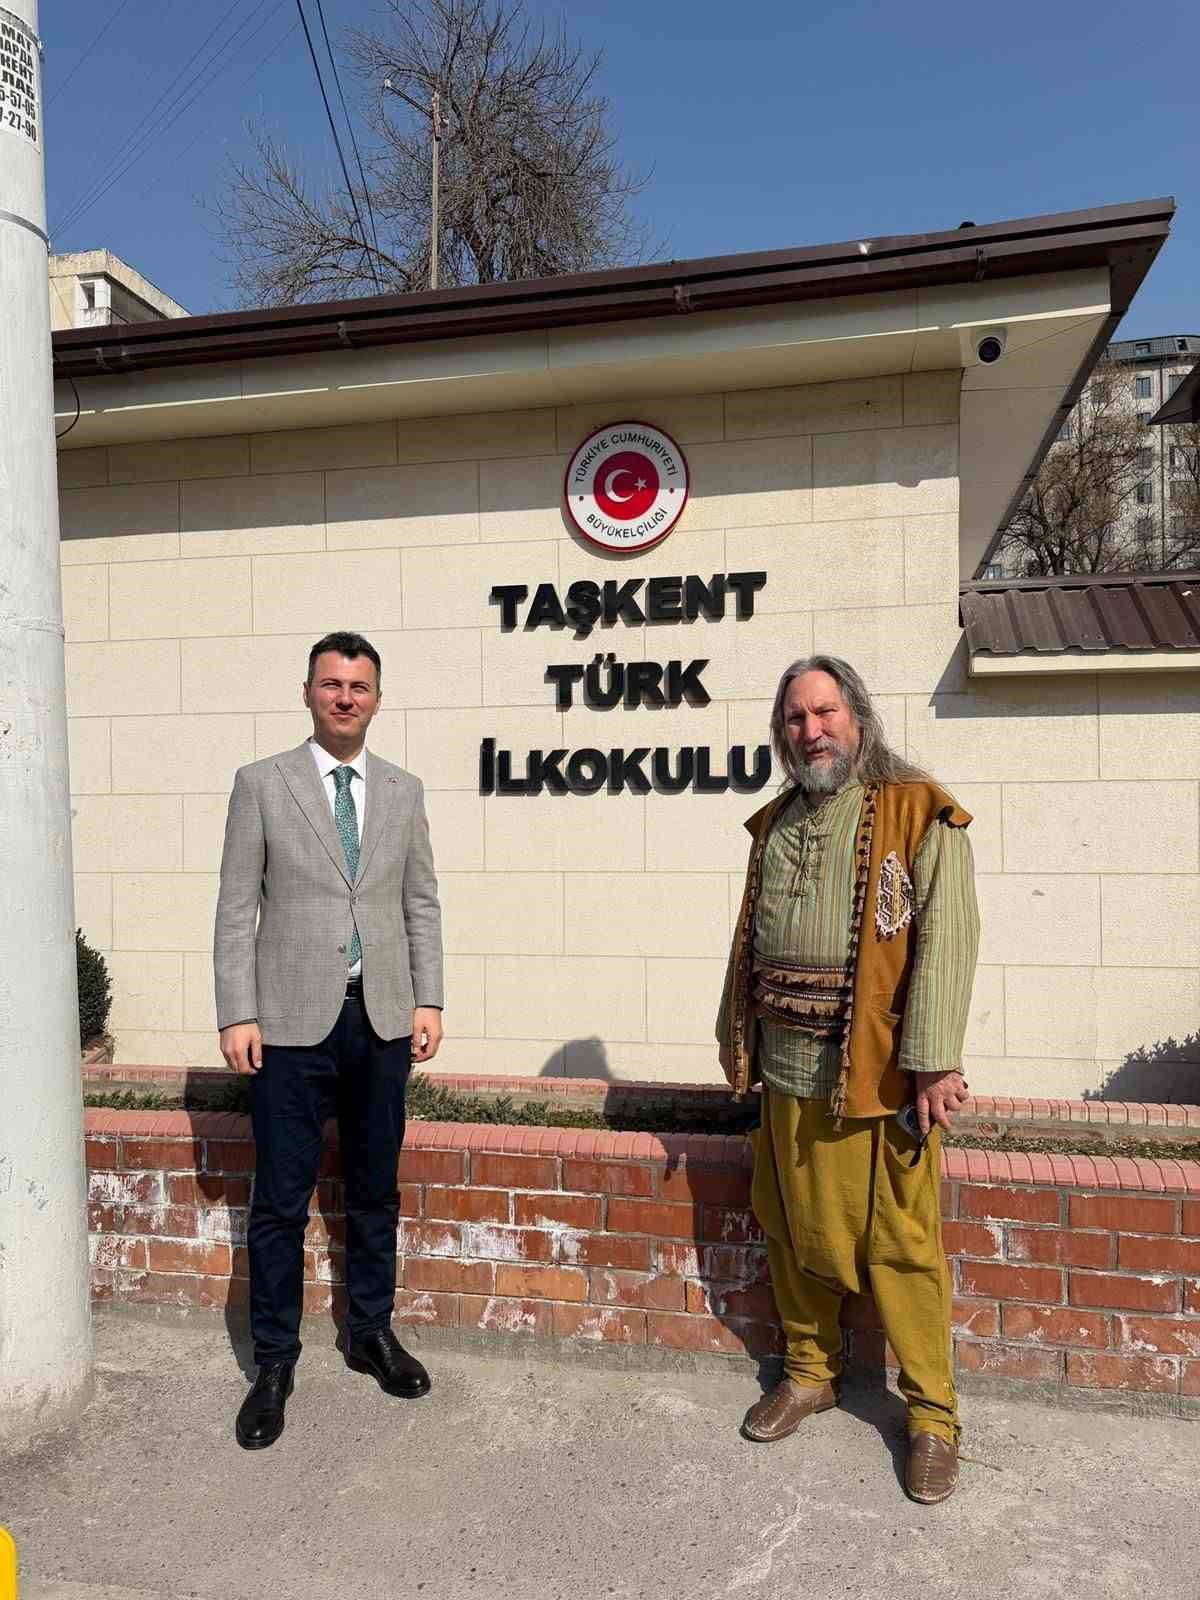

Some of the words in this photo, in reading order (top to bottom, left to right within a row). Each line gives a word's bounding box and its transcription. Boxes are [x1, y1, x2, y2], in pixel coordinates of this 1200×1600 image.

[575, 439, 610, 482] TÜRKİYE
[610, 431, 679, 476] CUMHURİYETİ
[586, 507, 668, 538] BÜYÜKELÇİLİĞİ
[489, 571, 767, 640] TAŞKENT
[544, 653, 711, 712] TÜRK
[479, 737, 771, 796] İLKOKULU
